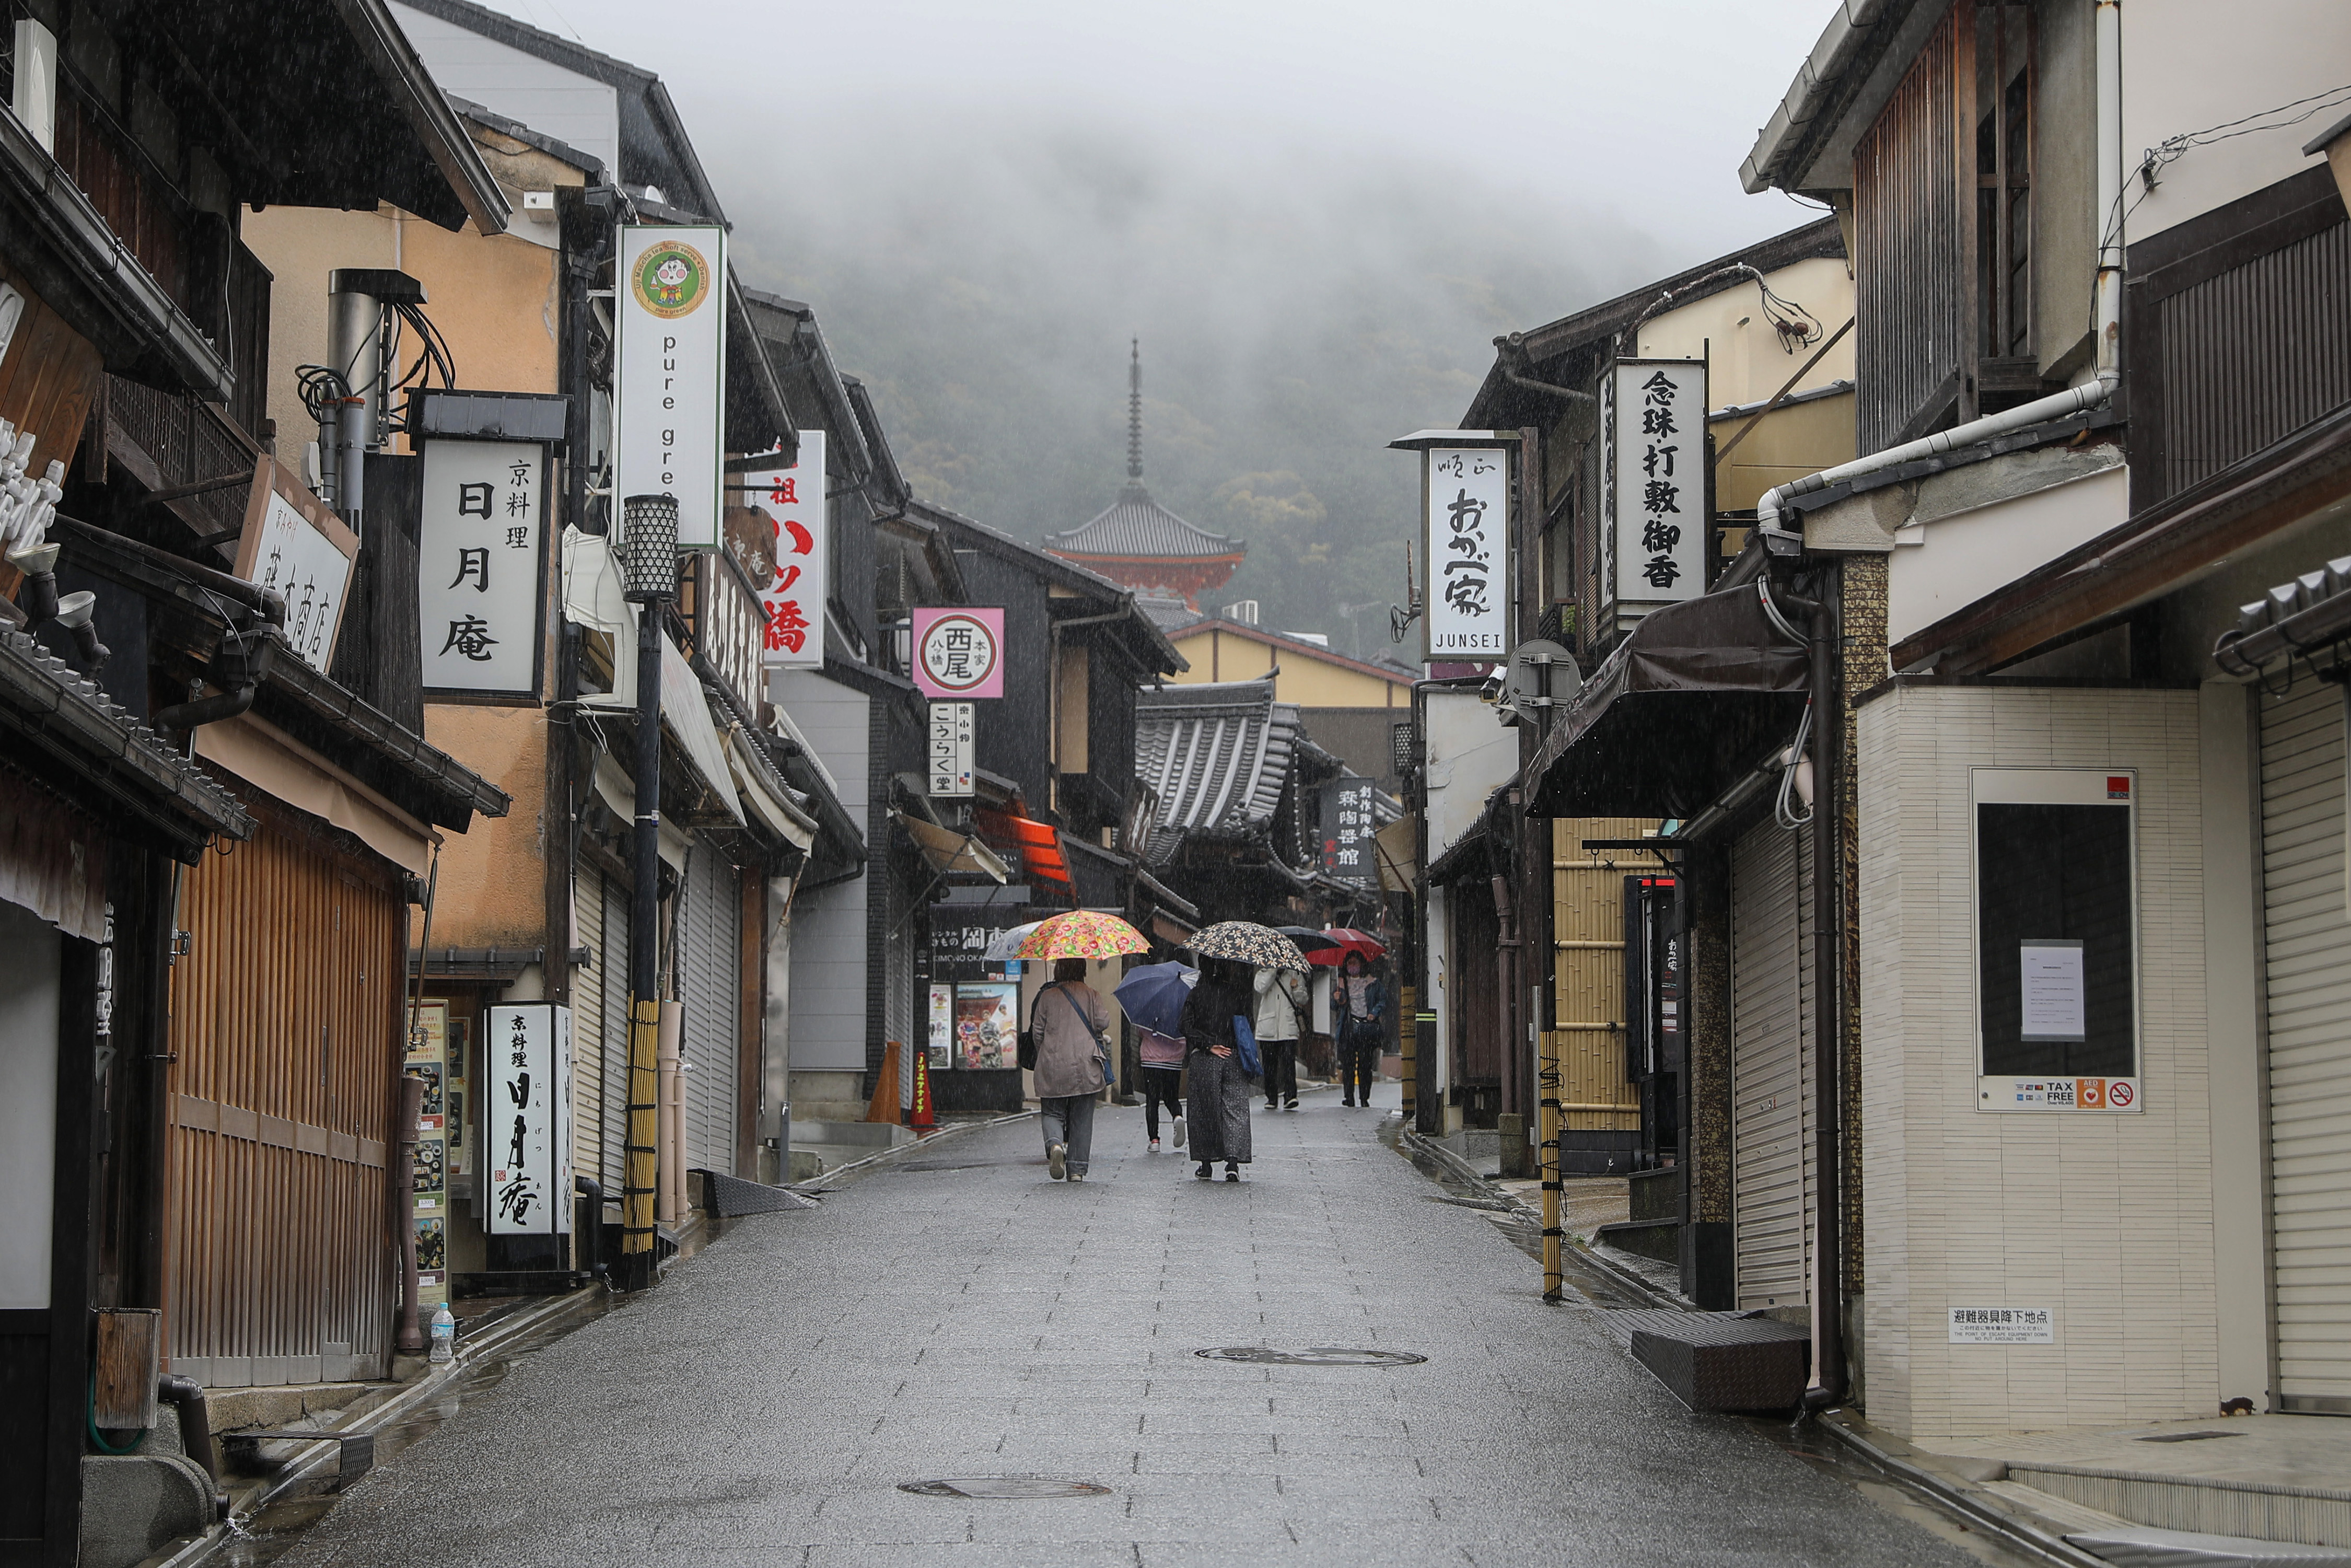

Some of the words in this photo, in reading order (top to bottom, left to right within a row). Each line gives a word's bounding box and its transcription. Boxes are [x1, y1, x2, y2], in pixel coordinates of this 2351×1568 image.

[635, 254, 651, 278] Maccha
[680, 247, 697, 261] serve
[669, 306, 686, 315] green
[662, 335, 677, 410] pure
[505, 459, 532, 549] 京料理
[438, 481, 500, 661] 日月庵
[723, 527, 767, 576] 京庵
[1444, 488, 1492, 617] おかべ家
[941, 627, 973, 679] 西尾
[974, 640, 987, 667] 本家
[1435, 633, 1501, 648] JUNSEI
[936, 707, 950, 791] こうらく堂
[934, 954, 965, 962] KIMONO
[510, 1014, 528, 1068] 京料理
[2047, 1082, 2073, 1091] TAX
[2047, 1092, 2074, 1101] FREE
[498, 1072, 538, 1226] 日月庵
[1953, 1309, 2048, 1324] 避難器具降下地点
